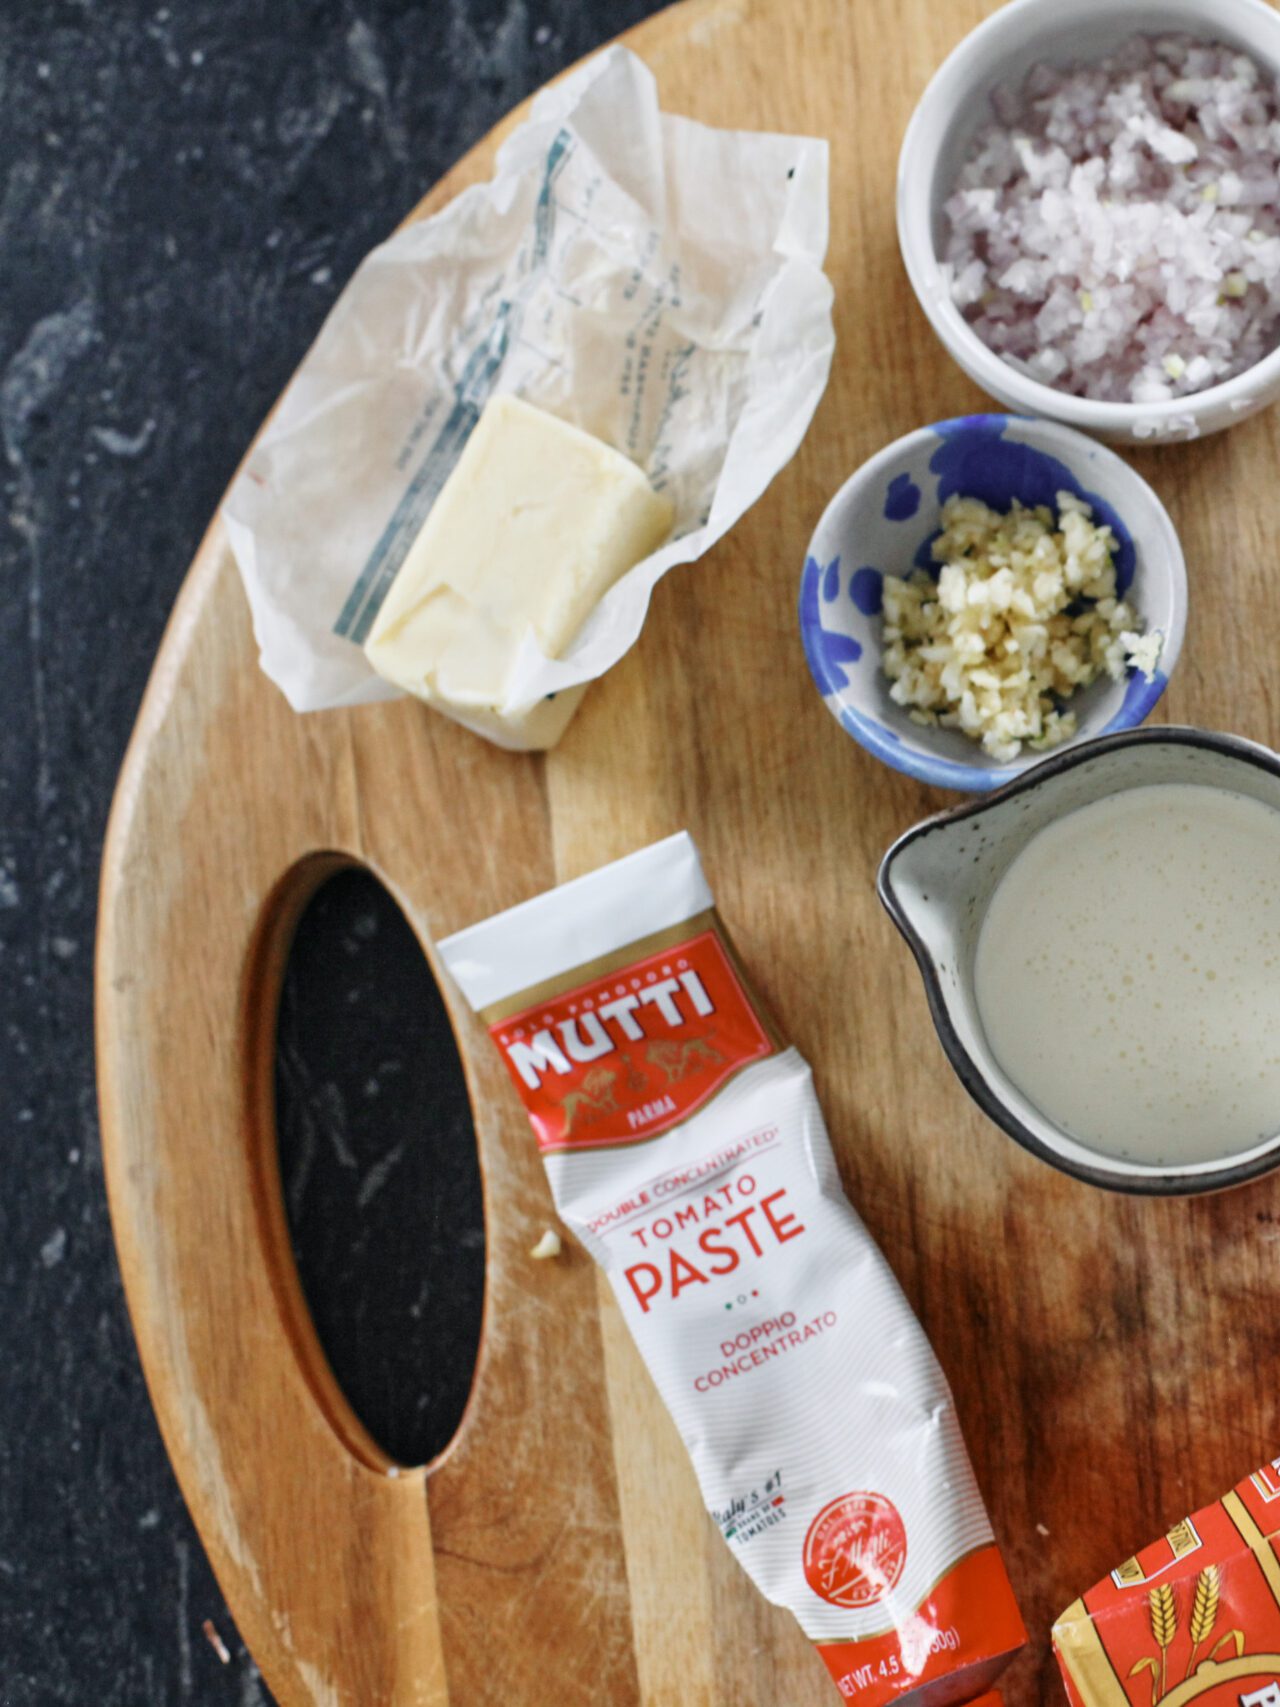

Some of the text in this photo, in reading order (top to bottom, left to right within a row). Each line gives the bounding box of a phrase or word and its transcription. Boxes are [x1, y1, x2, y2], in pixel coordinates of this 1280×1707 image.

[507, 969, 715, 1090] MUTTI
[626, 1094, 677, 1130] PARMA
[587, 1191, 651, 1233] DOUBLE
[631, 1174, 757, 1248] TOMATO
[623, 1188, 806, 1314] PASTE
[694, 1311, 837, 1392] CONCENTRATO
[720, 1311, 797, 1358] DOPPIO
[852, 1664, 878, 1690] WT.
[879, 1655, 899, 1677] 4.5
